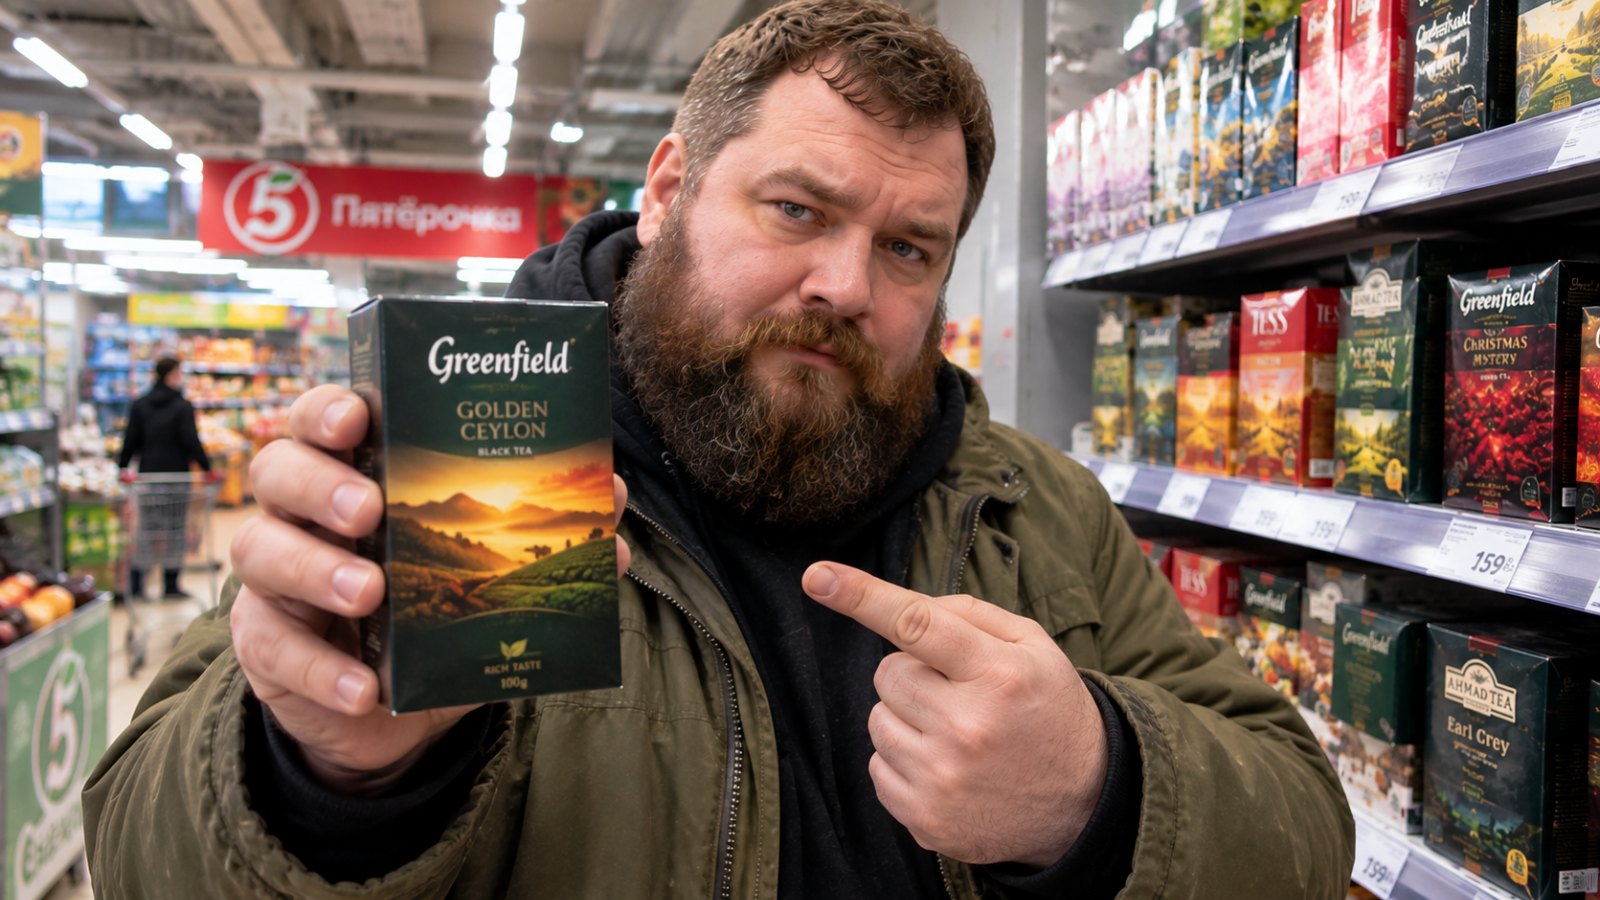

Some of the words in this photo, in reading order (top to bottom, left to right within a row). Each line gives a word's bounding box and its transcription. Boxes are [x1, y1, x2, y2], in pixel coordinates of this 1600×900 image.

[331, 194, 521, 237] Пятёрочка
[1460, 282, 1537, 317] Greenfield
[1250, 306, 1289, 337] TESS
[428, 335, 569, 384] Greenfield
[456, 400, 549, 420] GOLDEN
[459, 421, 547, 442] CEYLON
[477, 447, 511, 457] BLACK
[512, 446, 533, 456] TEA
[1470, 550, 1506, 576] 159
[483, 664, 509, 675] RICH
[512, 660, 542, 672] TASTE
[500, 676, 528, 690] 100g
[1447, 676, 1489, 701] AHMAD
[1490, 690, 1513, 712] TEA
[1447, 715, 1473, 741] Earl
[1362, 856, 1388, 883] 159
